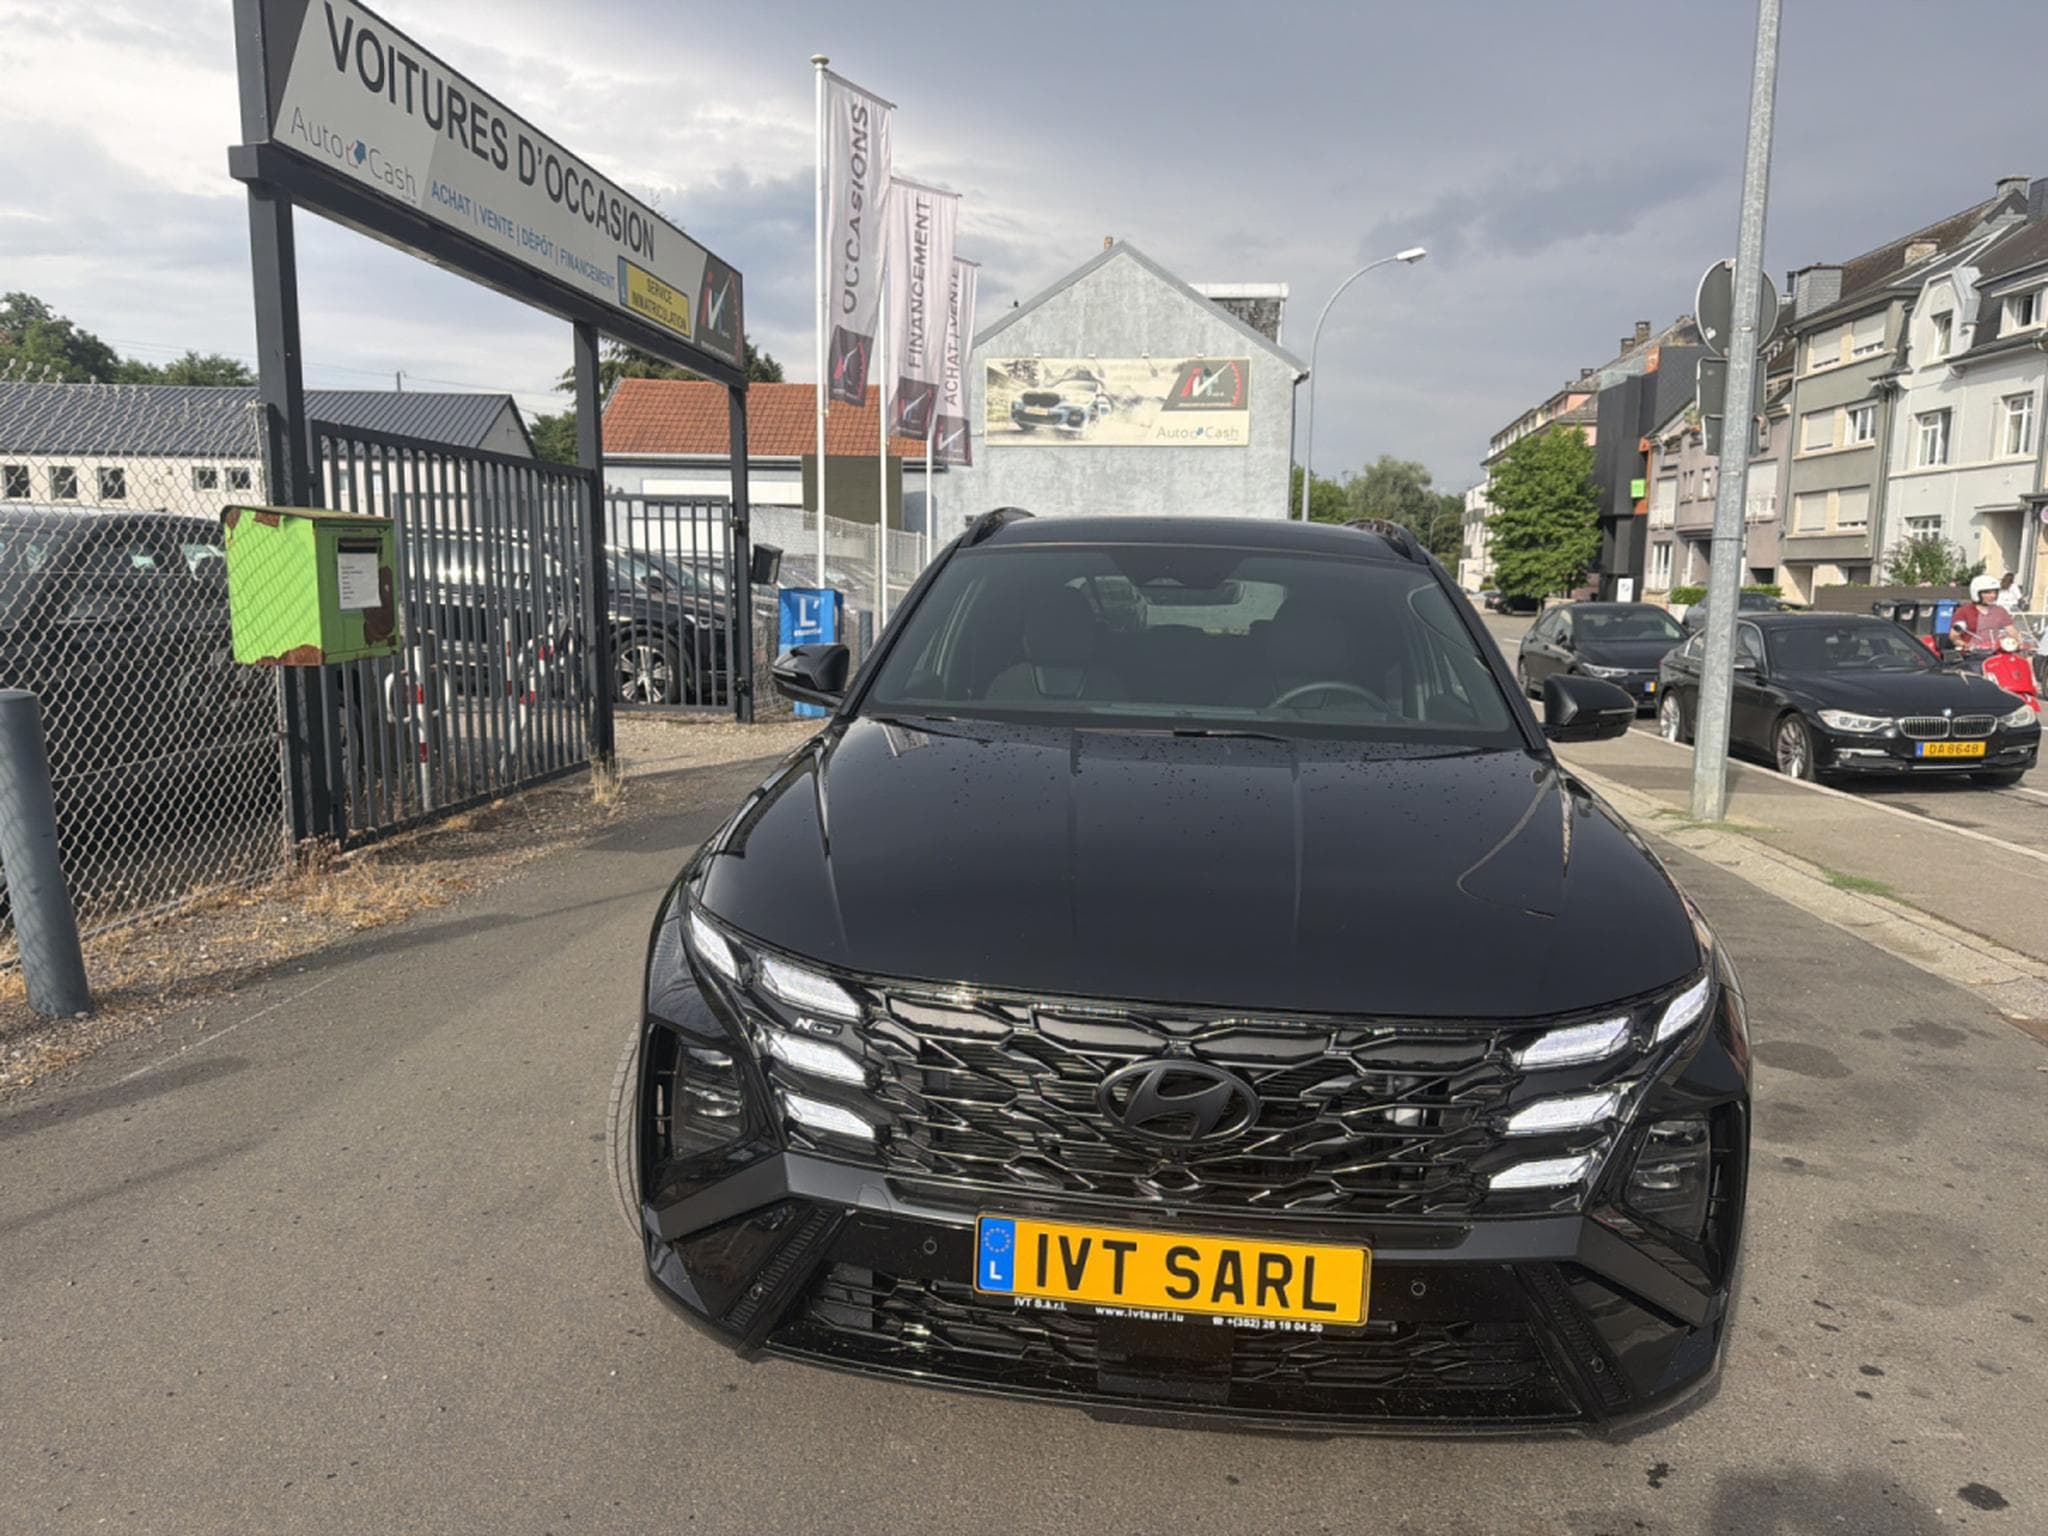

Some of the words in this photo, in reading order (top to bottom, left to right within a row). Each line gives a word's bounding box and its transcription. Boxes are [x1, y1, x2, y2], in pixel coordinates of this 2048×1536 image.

[324, 1, 509, 171] VOITURES
[518, 134, 655, 262] D'OCCASION
[369, 148, 417, 197] Cash
[842, 103, 869, 315] OCCASIONS
[431, 180, 471, 216] ACHAT
[480, 207, 515, 239] VENTE
[521, 227, 554, 258] DÉPÔT
[560, 249, 616, 288] FINANCEMENT
[908, 197, 931, 369] FINANCEMENT
[944, 342, 960, 406] ACHAT
[989, 1261, 1002, 1280] L
[1036, 1233, 1138, 1295] IVT
[1165, 1245, 1336, 1312] SARL
[1094, 1306, 1184, 1322] www.ivtsarl.lu
